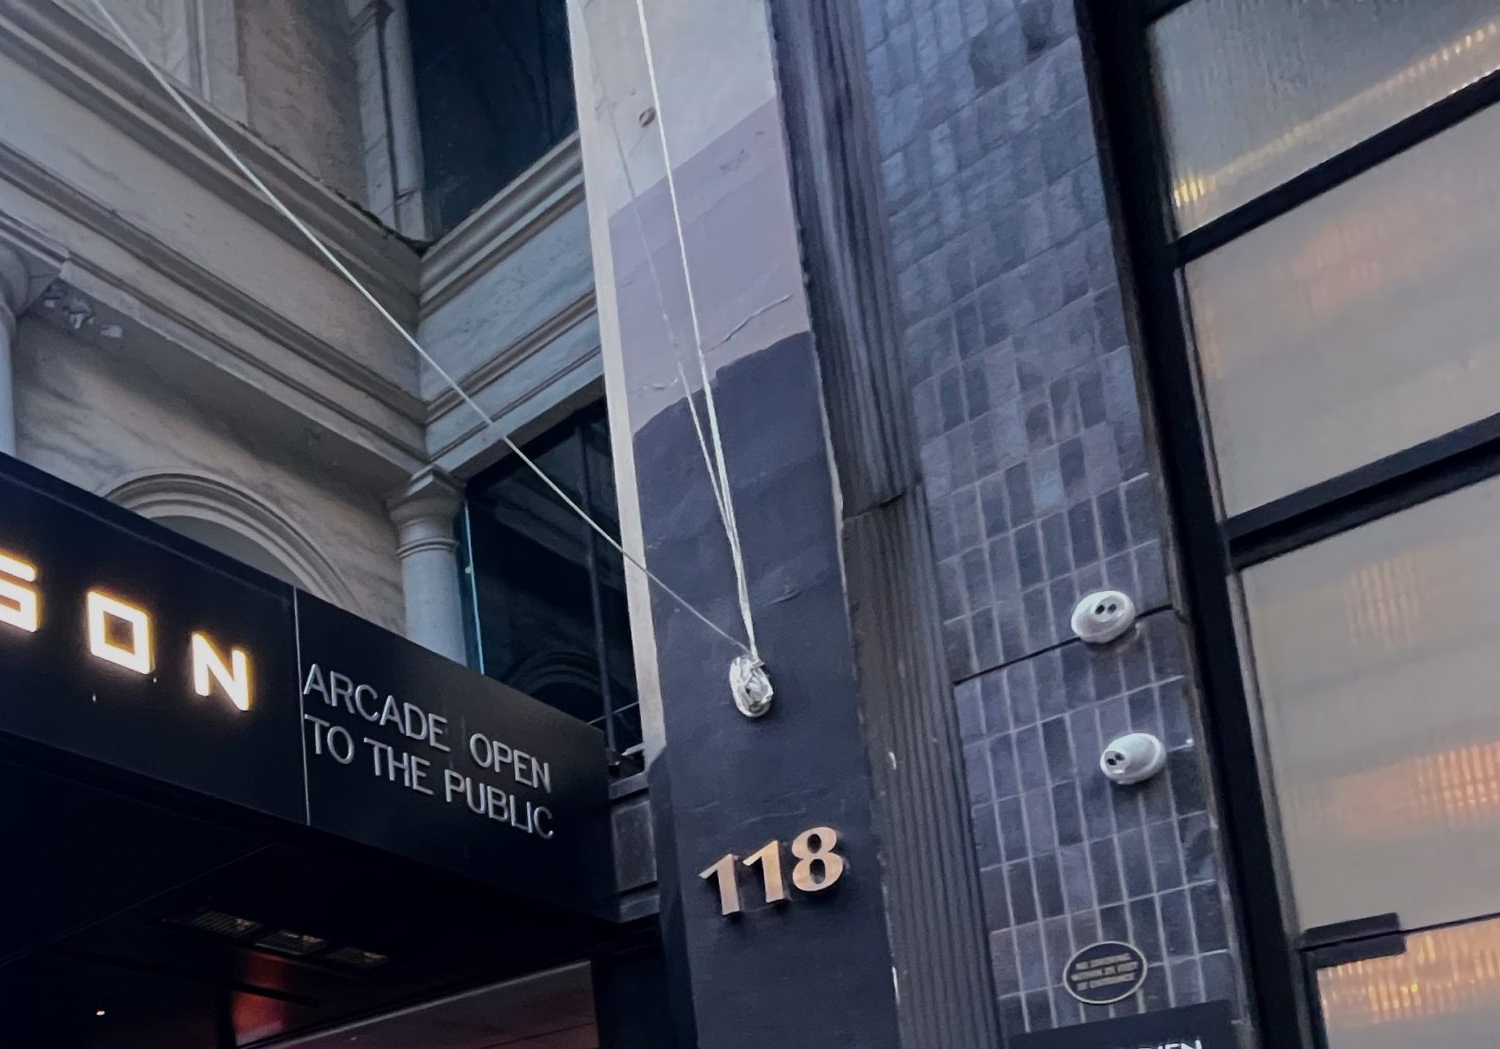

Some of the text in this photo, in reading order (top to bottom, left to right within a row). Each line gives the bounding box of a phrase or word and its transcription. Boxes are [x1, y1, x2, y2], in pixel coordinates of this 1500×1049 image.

[303, 663, 551, 793] ARCADE OPEN
[304, 714, 554, 839] TO THE PUBLIC
[699, 826, 844, 916] 118
